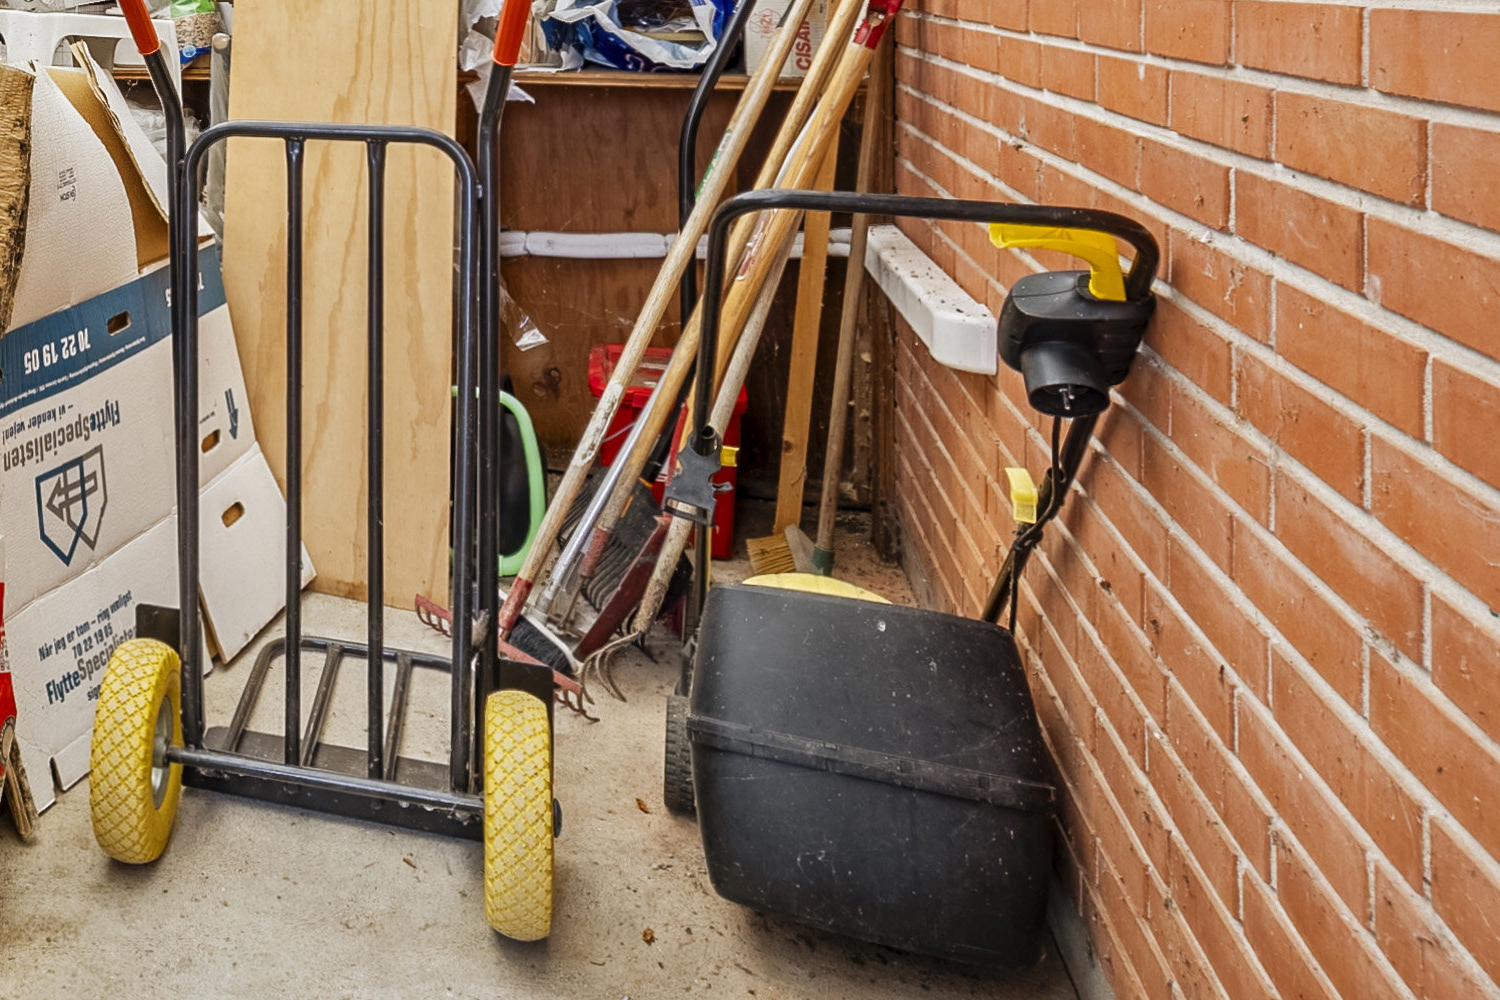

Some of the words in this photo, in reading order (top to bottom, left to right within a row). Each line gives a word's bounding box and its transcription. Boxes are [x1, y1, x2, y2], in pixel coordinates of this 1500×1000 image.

[60, 334, 77, 359] 22
[77, 327, 91, 352] 70
[23, 349, 40, 375] 05
[42, 342, 58, 367] 19
[27, 411, 57, 430] kender
[58, 404, 66, 420] vi
[2, 421, 25, 446] vejen!
[3, 399, 120, 472] FlytteSpecialisten
[38, 643, 53, 661] Når
[53, 638, 67, 655] jeg
[66, 630, 75, 643] er
[75, 621, 91, 637] tom
[97, 608, 111, 623] ring
[110, 589, 133, 614] venligst
[71, 642, 83, 659] 70
[83, 636, 93, 653] 22
[94, 628, 104, 645] 19
[104, 622, 113, 638] 05
